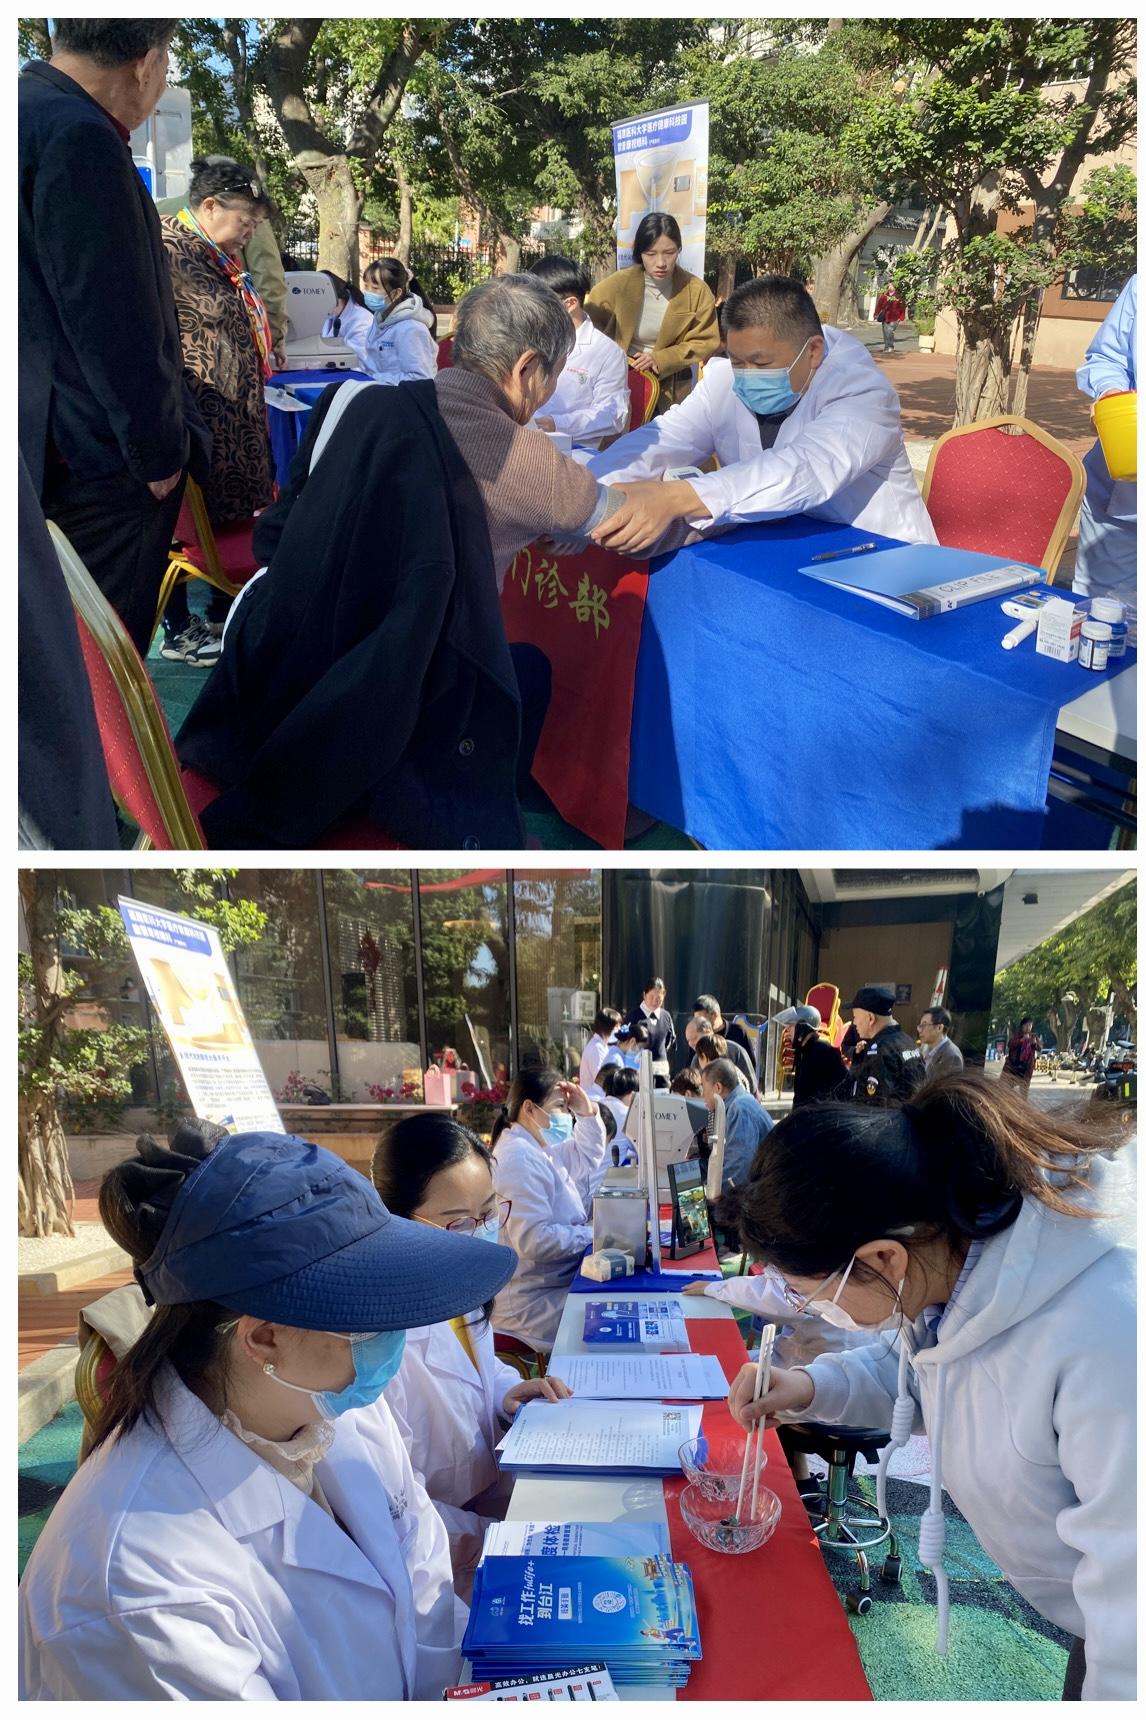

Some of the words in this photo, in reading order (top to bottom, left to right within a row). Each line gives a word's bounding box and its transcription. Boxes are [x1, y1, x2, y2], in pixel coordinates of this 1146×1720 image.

[303, 287, 326, 295] TOMEY
[938, 580, 969, 593] CLIP
[511, 547, 611, 640] 门诊部
[653, 1111, 678, 1121] OMEY
[537, 1583, 553, 1620] 到台江
